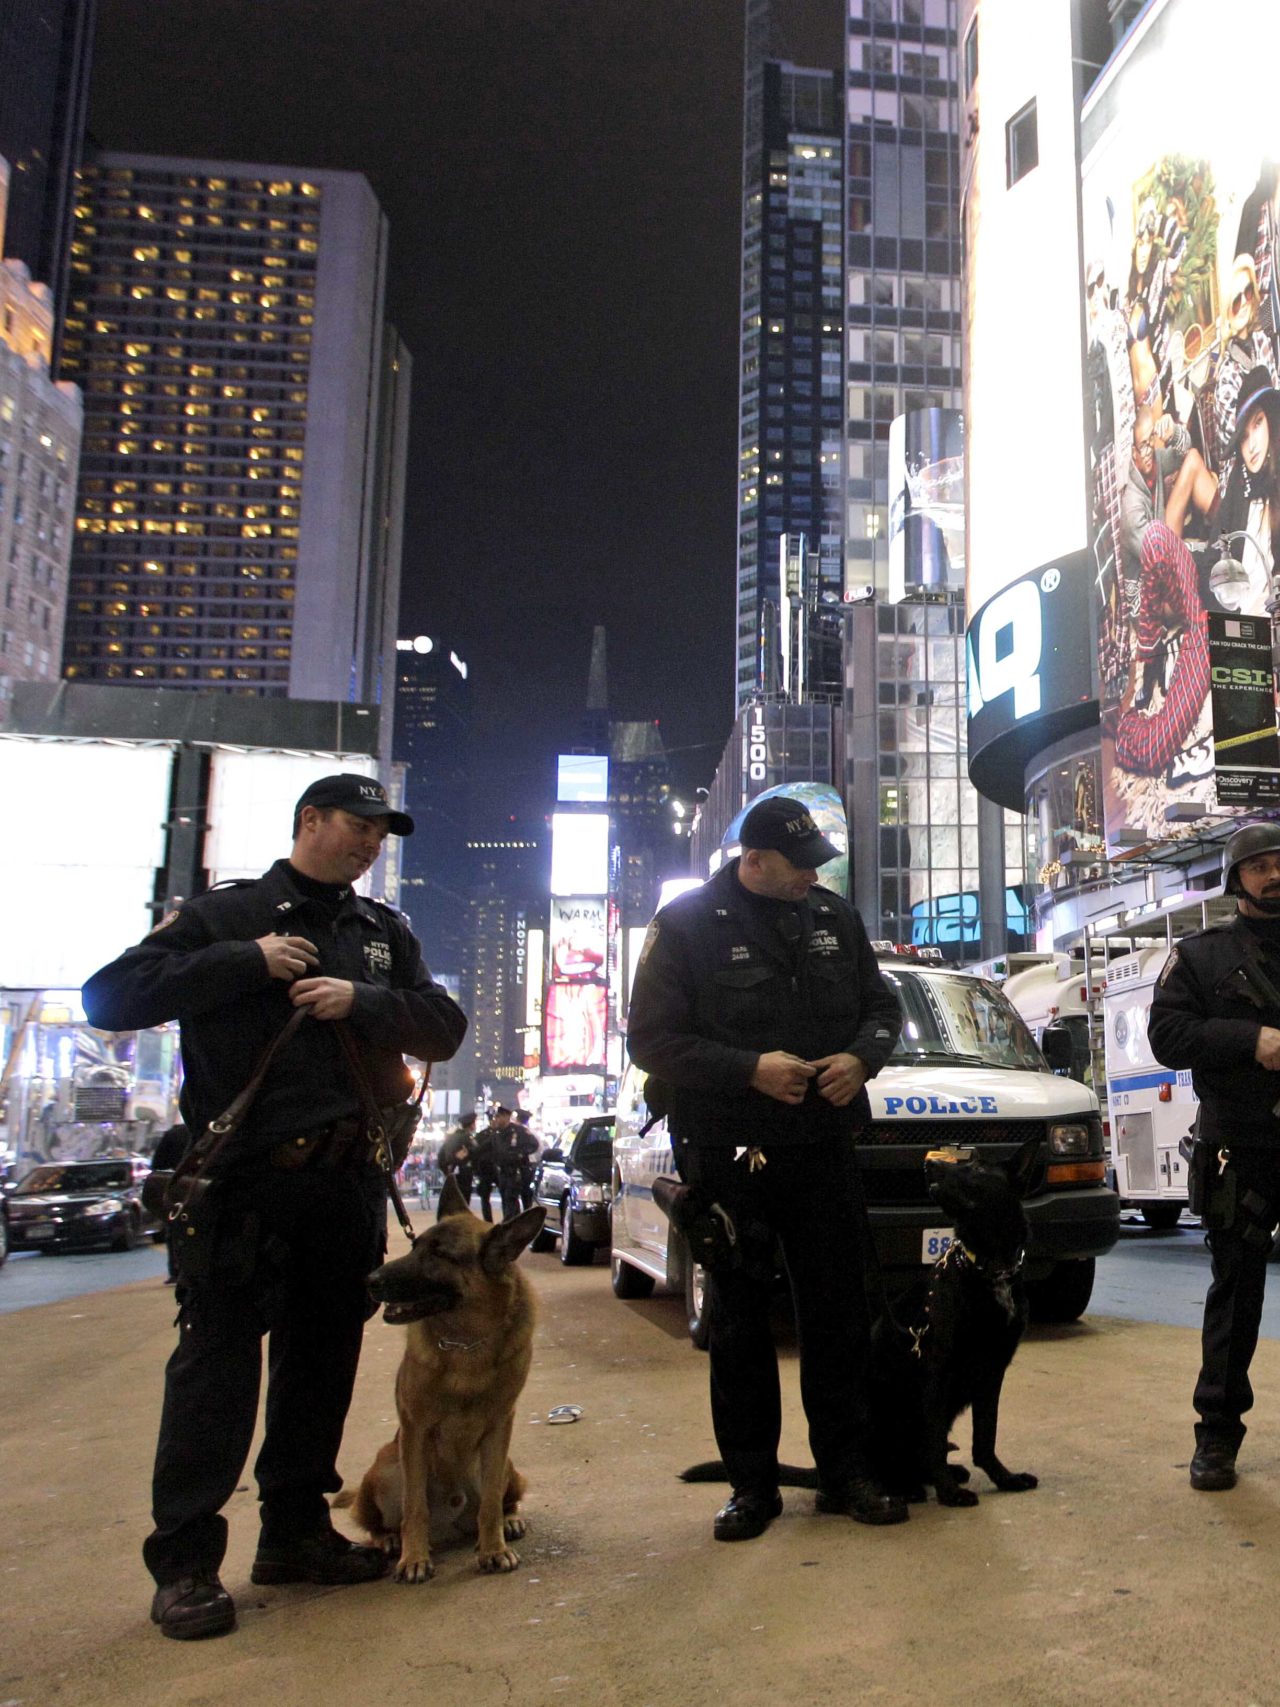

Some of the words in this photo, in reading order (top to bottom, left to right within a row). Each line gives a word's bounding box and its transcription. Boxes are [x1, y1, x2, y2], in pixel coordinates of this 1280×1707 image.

[1212, 666, 1273, 686] CSI:
[1229, 684, 1273, 693] EXPERIENCE
[749, 706, 766, 781] 1500
[516, 920, 526, 985] NOVOTEL
[884, 1096, 999, 1115] POLICE
